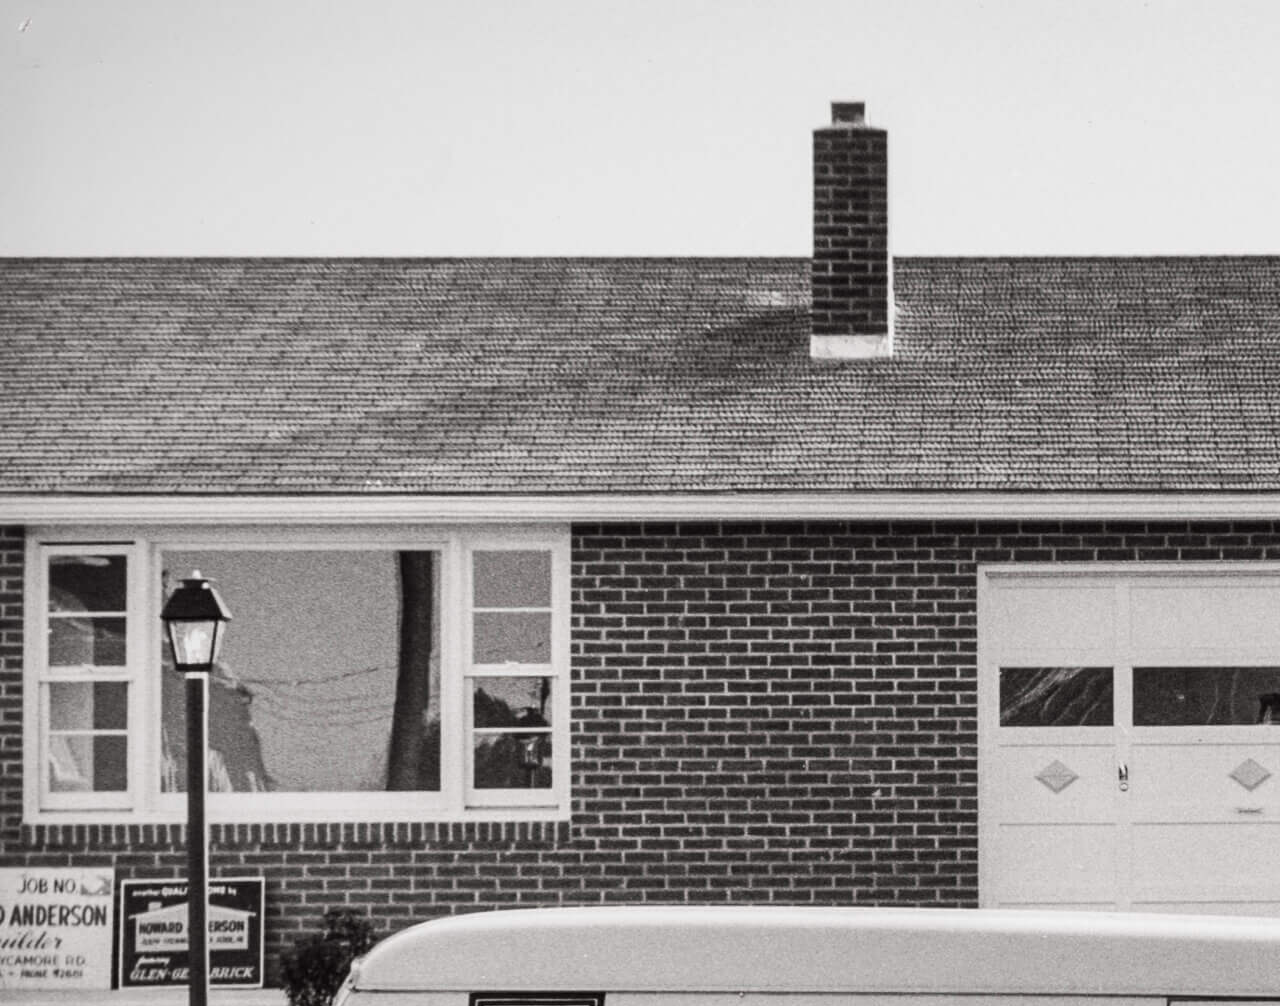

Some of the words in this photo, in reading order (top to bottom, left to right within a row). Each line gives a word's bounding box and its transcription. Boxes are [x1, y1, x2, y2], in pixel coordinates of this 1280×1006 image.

[17, 878, 48, 895] JOB
[9, 904, 108, 927] ANDERSON
[139, 922, 184, 935] HOWARD
[209, 966, 256, 979] BRICK
